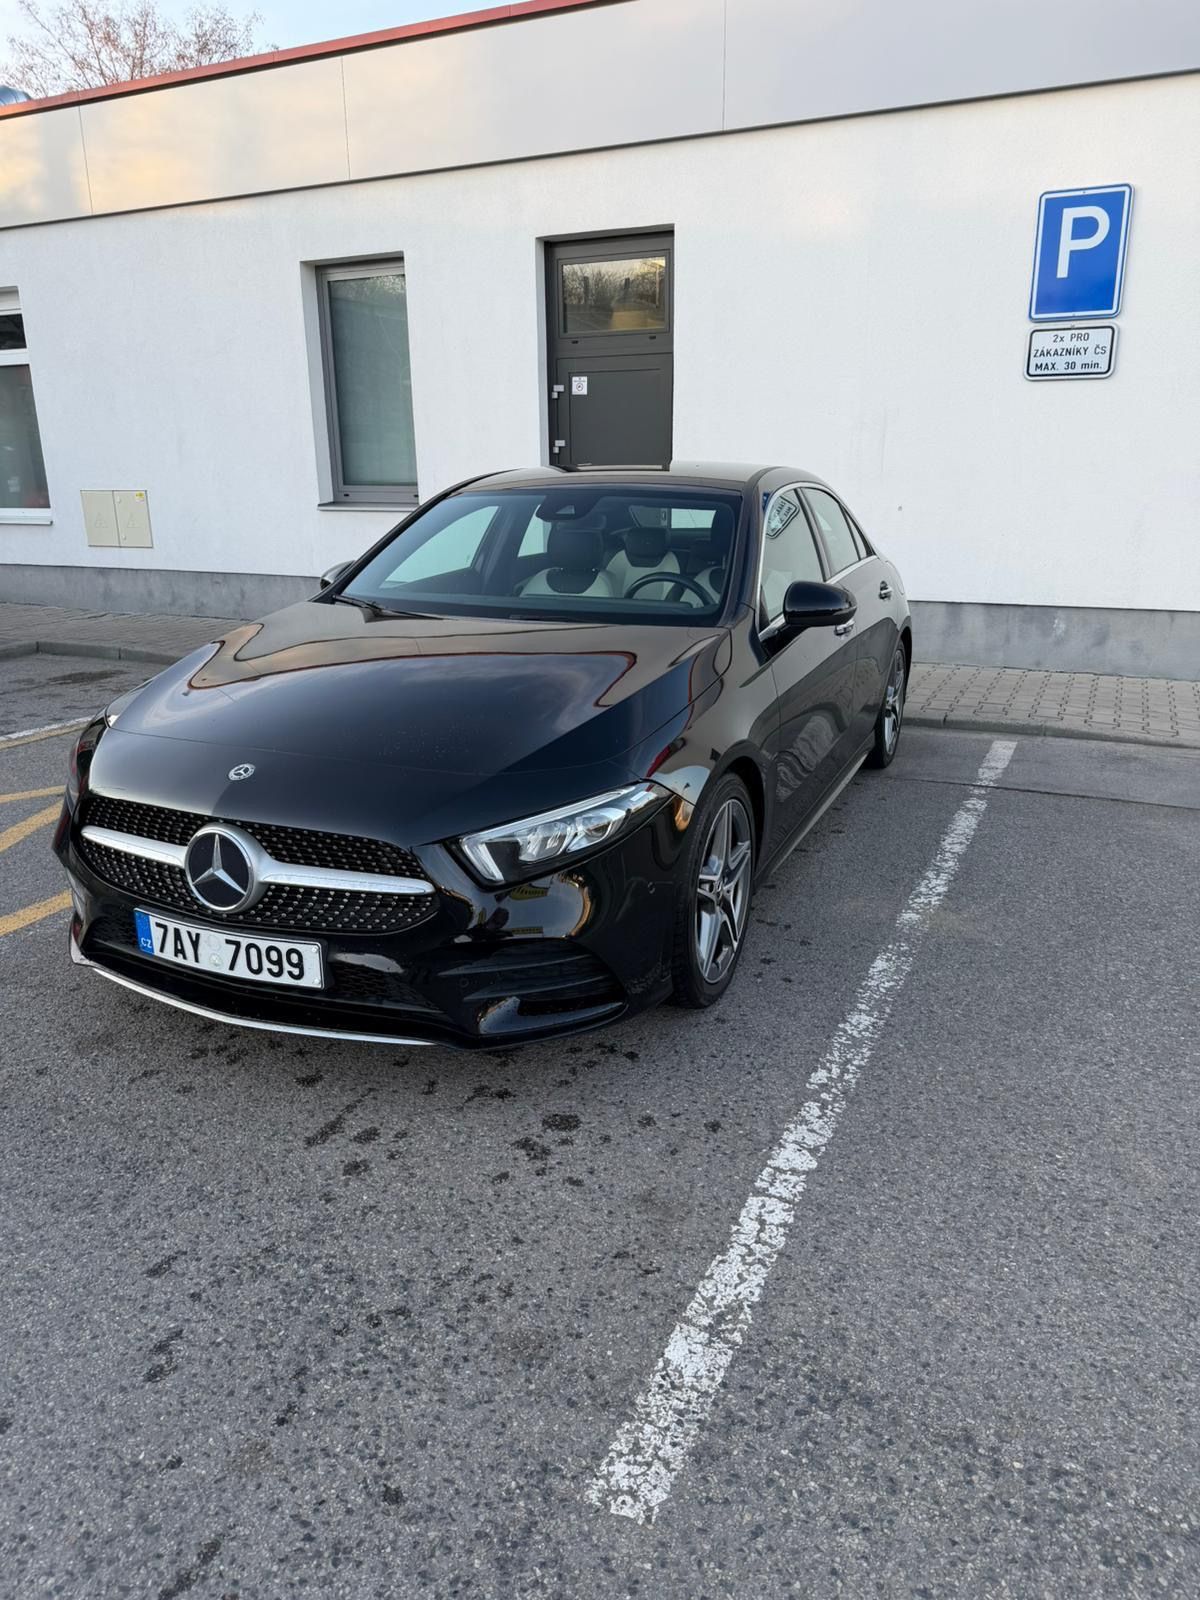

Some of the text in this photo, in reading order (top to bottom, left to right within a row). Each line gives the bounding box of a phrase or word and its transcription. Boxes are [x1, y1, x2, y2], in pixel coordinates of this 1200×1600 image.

[1056, 205, 1110, 279] P
[1053, 332, 1090, 343] 2x PRO
[1033, 344, 1107, 358] ZÁKAZNÍKY ČS
[1035, 360, 1102, 371] MAX. 30 min.
[140, 938, 152, 948] CZ
[155, 922, 305, 980] 7AY 7099
